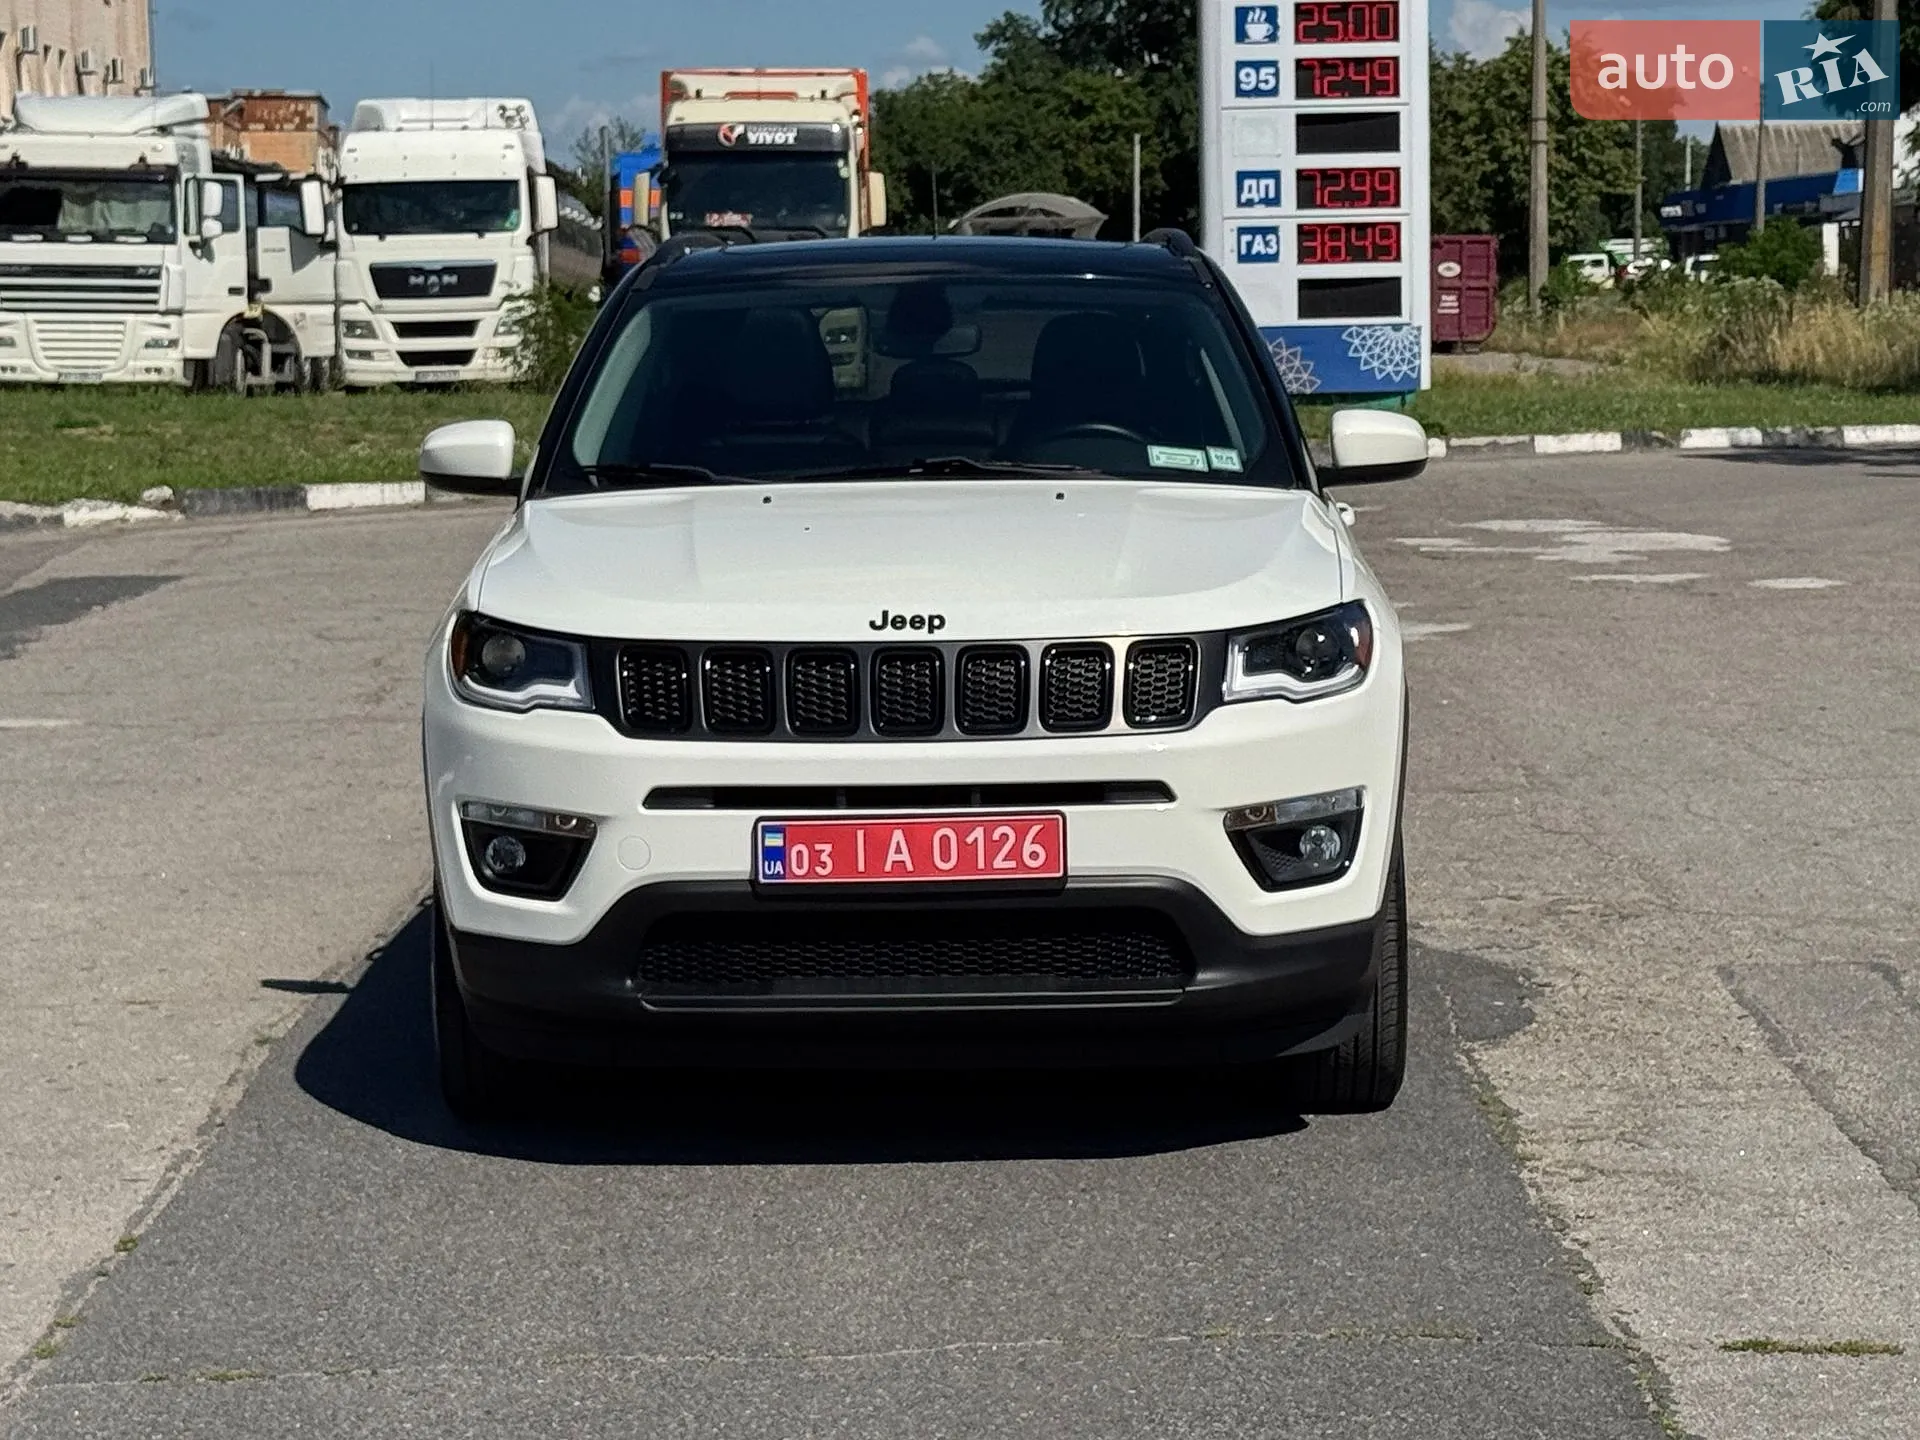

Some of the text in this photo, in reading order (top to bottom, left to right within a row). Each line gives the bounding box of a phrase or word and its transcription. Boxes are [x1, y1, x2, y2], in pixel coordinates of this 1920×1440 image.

[1298, 4, 1394, 42] 25.00
[1239, 59, 1394, 97] 95 72.49
[747, 129, 797, 145] VIVOT
[1241, 169, 1395, 208] ДП 72.99
[1240, 224, 1398, 263] ГАЗ 38.49
[869, 610, 946, 634] Jeep
[764, 860, 784, 875] UA
[790, 843, 834, 876] 03
[932, 824, 1048, 871] 0126
